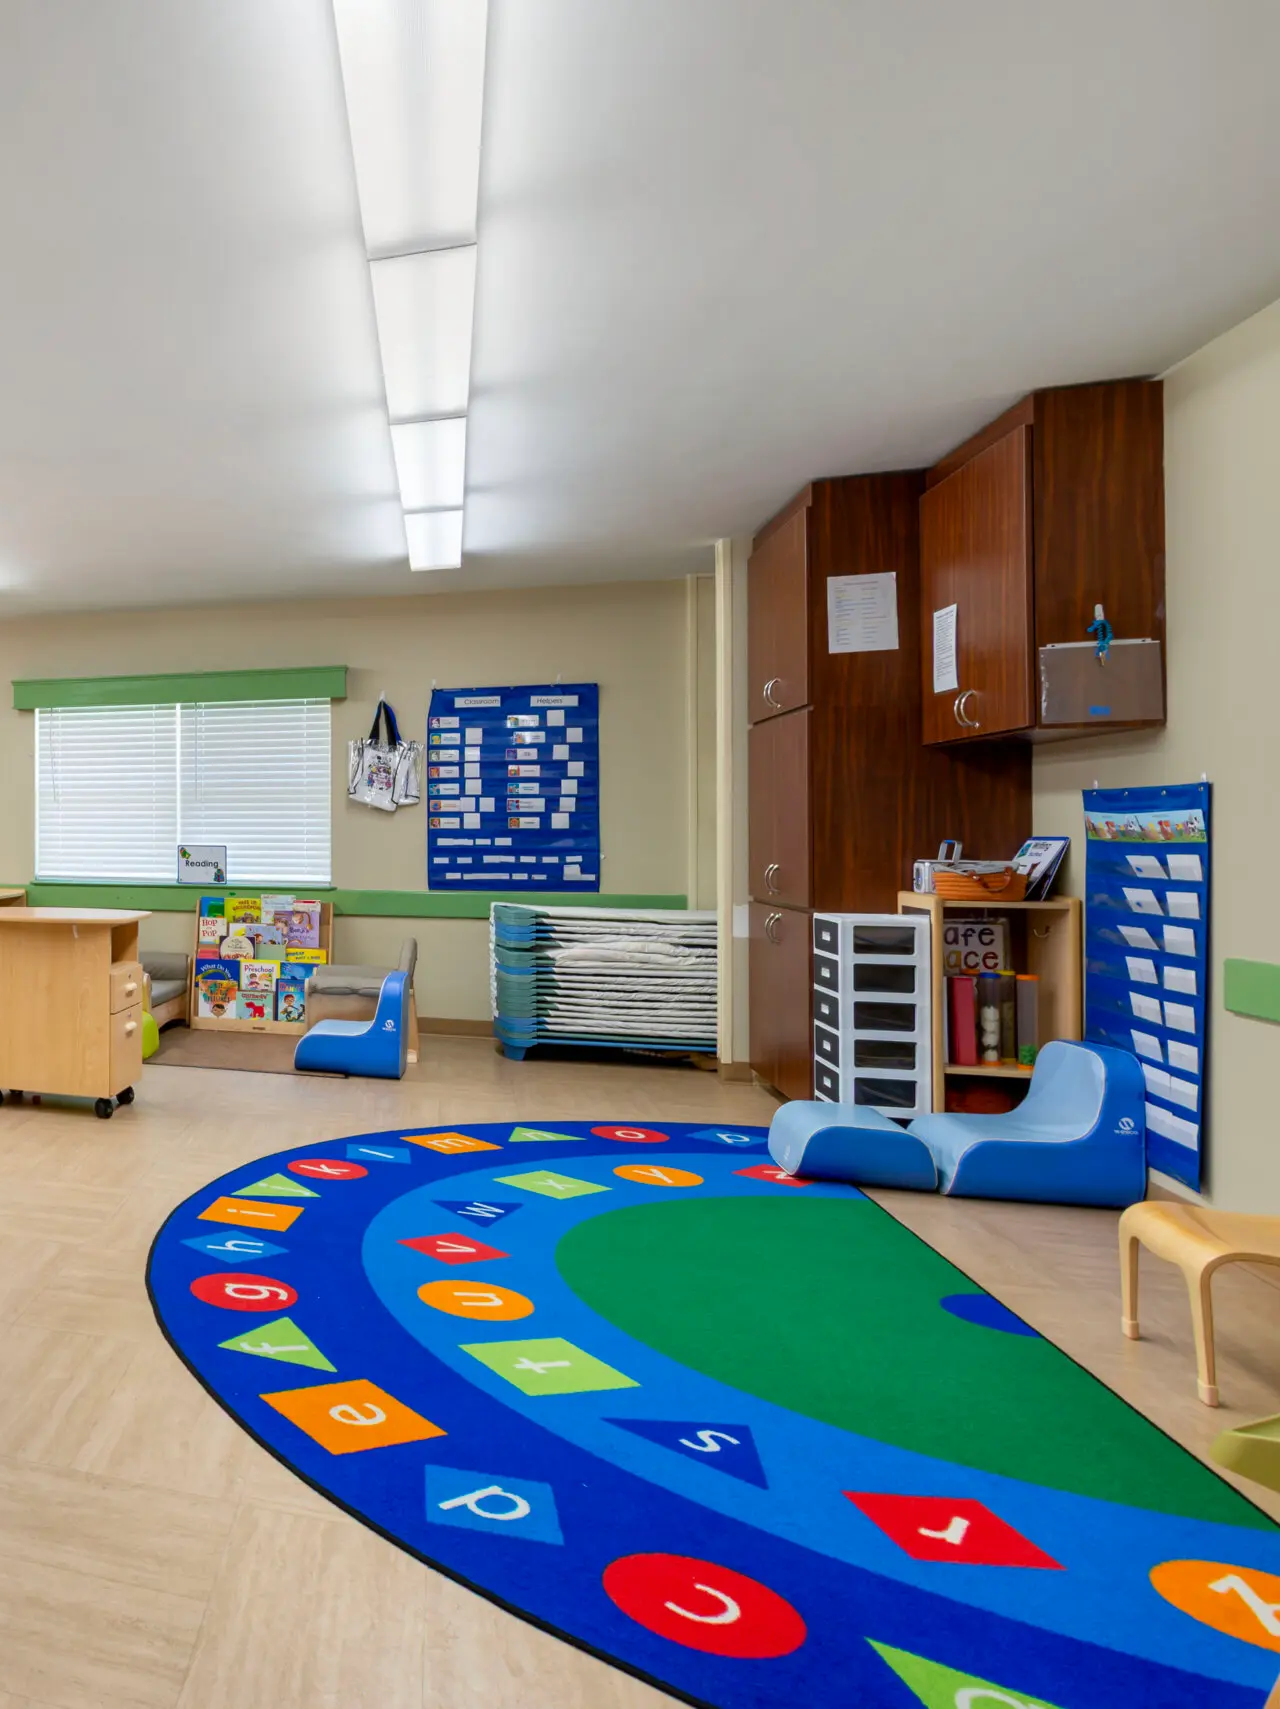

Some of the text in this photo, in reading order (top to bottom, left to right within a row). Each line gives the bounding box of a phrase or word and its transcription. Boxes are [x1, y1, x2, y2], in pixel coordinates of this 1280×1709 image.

[464, 697, 563, 706] Classroom Helpers
[185, 859, 219, 869] Reading
[200, 963, 216, 972] What
[243, 964, 275, 973] Preschool
[427, 1136, 475, 1149] m
[298, 1163, 351, 1176] k
[226, 1207, 277, 1218] i
[456, 1201, 505, 1218] w
[206, 1238, 265, 1254] h
[435, 1240, 477, 1253] v
[224, 1282, 289, 1301] g
[452, 1291, 504, 1307] u
[238, 1341, 310, 1355] f
[512, 1356, 573, 1375] t
[328, 1402, 387, 1426] e
[677, 1428, 741, 1453] s
[437, 1484, 531, 1521] d
[917, 1515, 970, 1546] r
[663, 1582, 742, 1625] c
